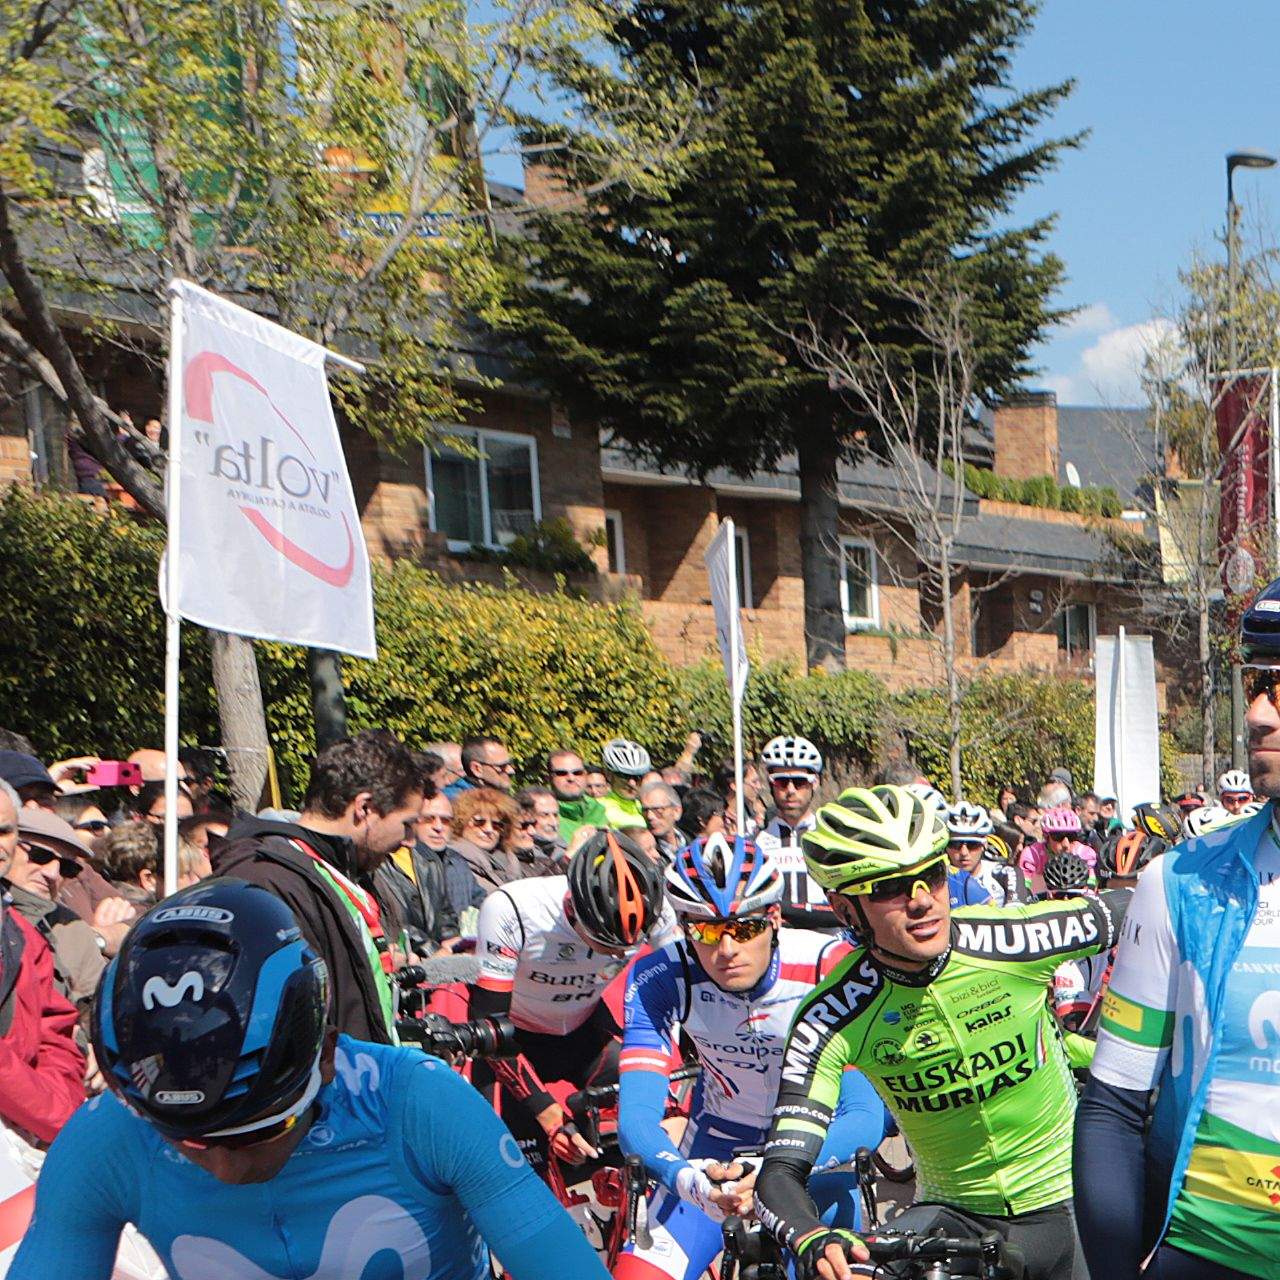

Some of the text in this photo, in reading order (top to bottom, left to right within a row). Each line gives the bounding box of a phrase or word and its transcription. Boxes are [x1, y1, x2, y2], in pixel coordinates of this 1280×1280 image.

[158, 906, 225, 921] ABUS
[957, 912, 1099, 955] MURIAS
[782, 959, 880, 1086] MURIAS
[956, 992, 1012, 1020] ORBEA
[965, 1004, 1012, 1034] kalas
[693, 1034, 784, 1057] Groupa
[881, 1032, 1028, 1093] EUSKADI
[892, 1057, 1034, 1113] MURIAS
